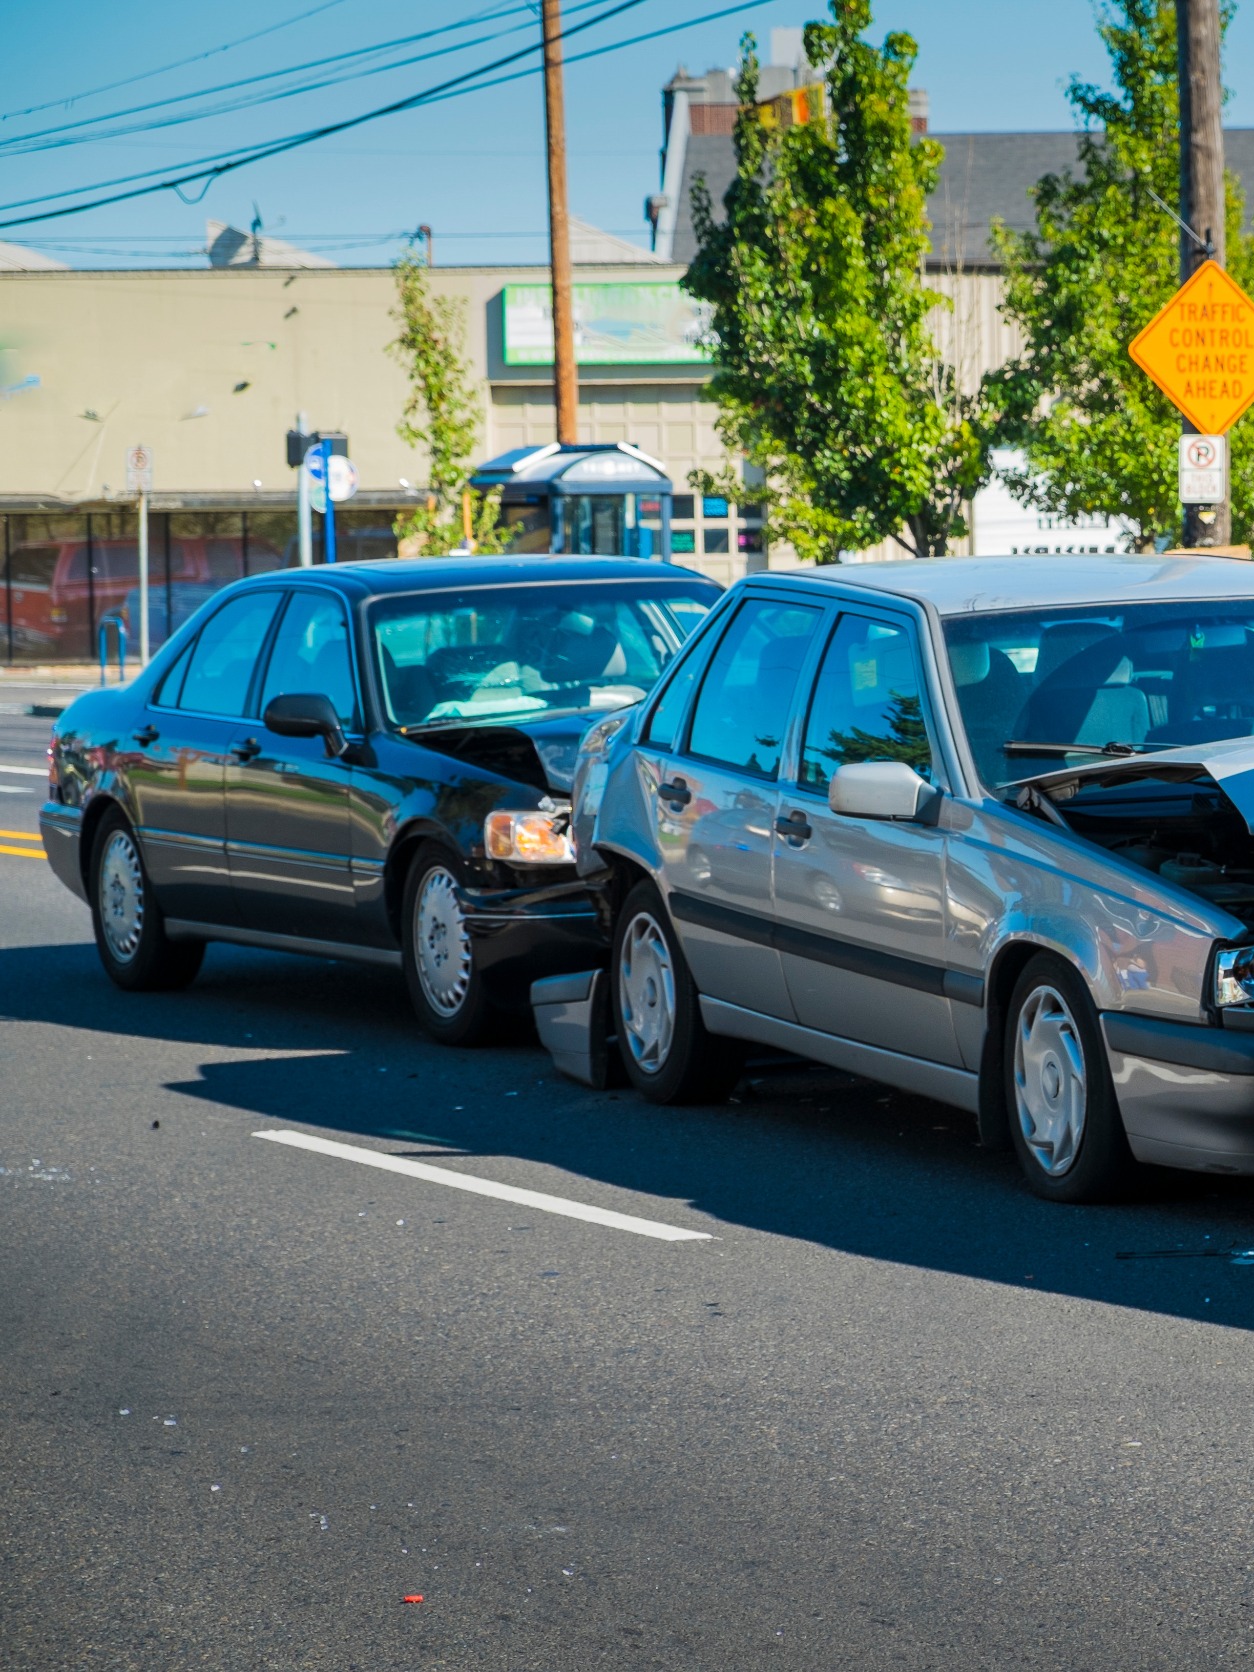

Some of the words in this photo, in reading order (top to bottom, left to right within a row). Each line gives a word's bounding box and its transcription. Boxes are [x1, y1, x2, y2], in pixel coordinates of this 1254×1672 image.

[1179, 303, 1247, 323] TRAFFIC
[1169, 327, 1254, 349] CONTROL
[1175, 353, 1249, 374] CHANGE
[1183, 379, 1243, 400] AHEAD
[1196, 446, 1210, 462] P
